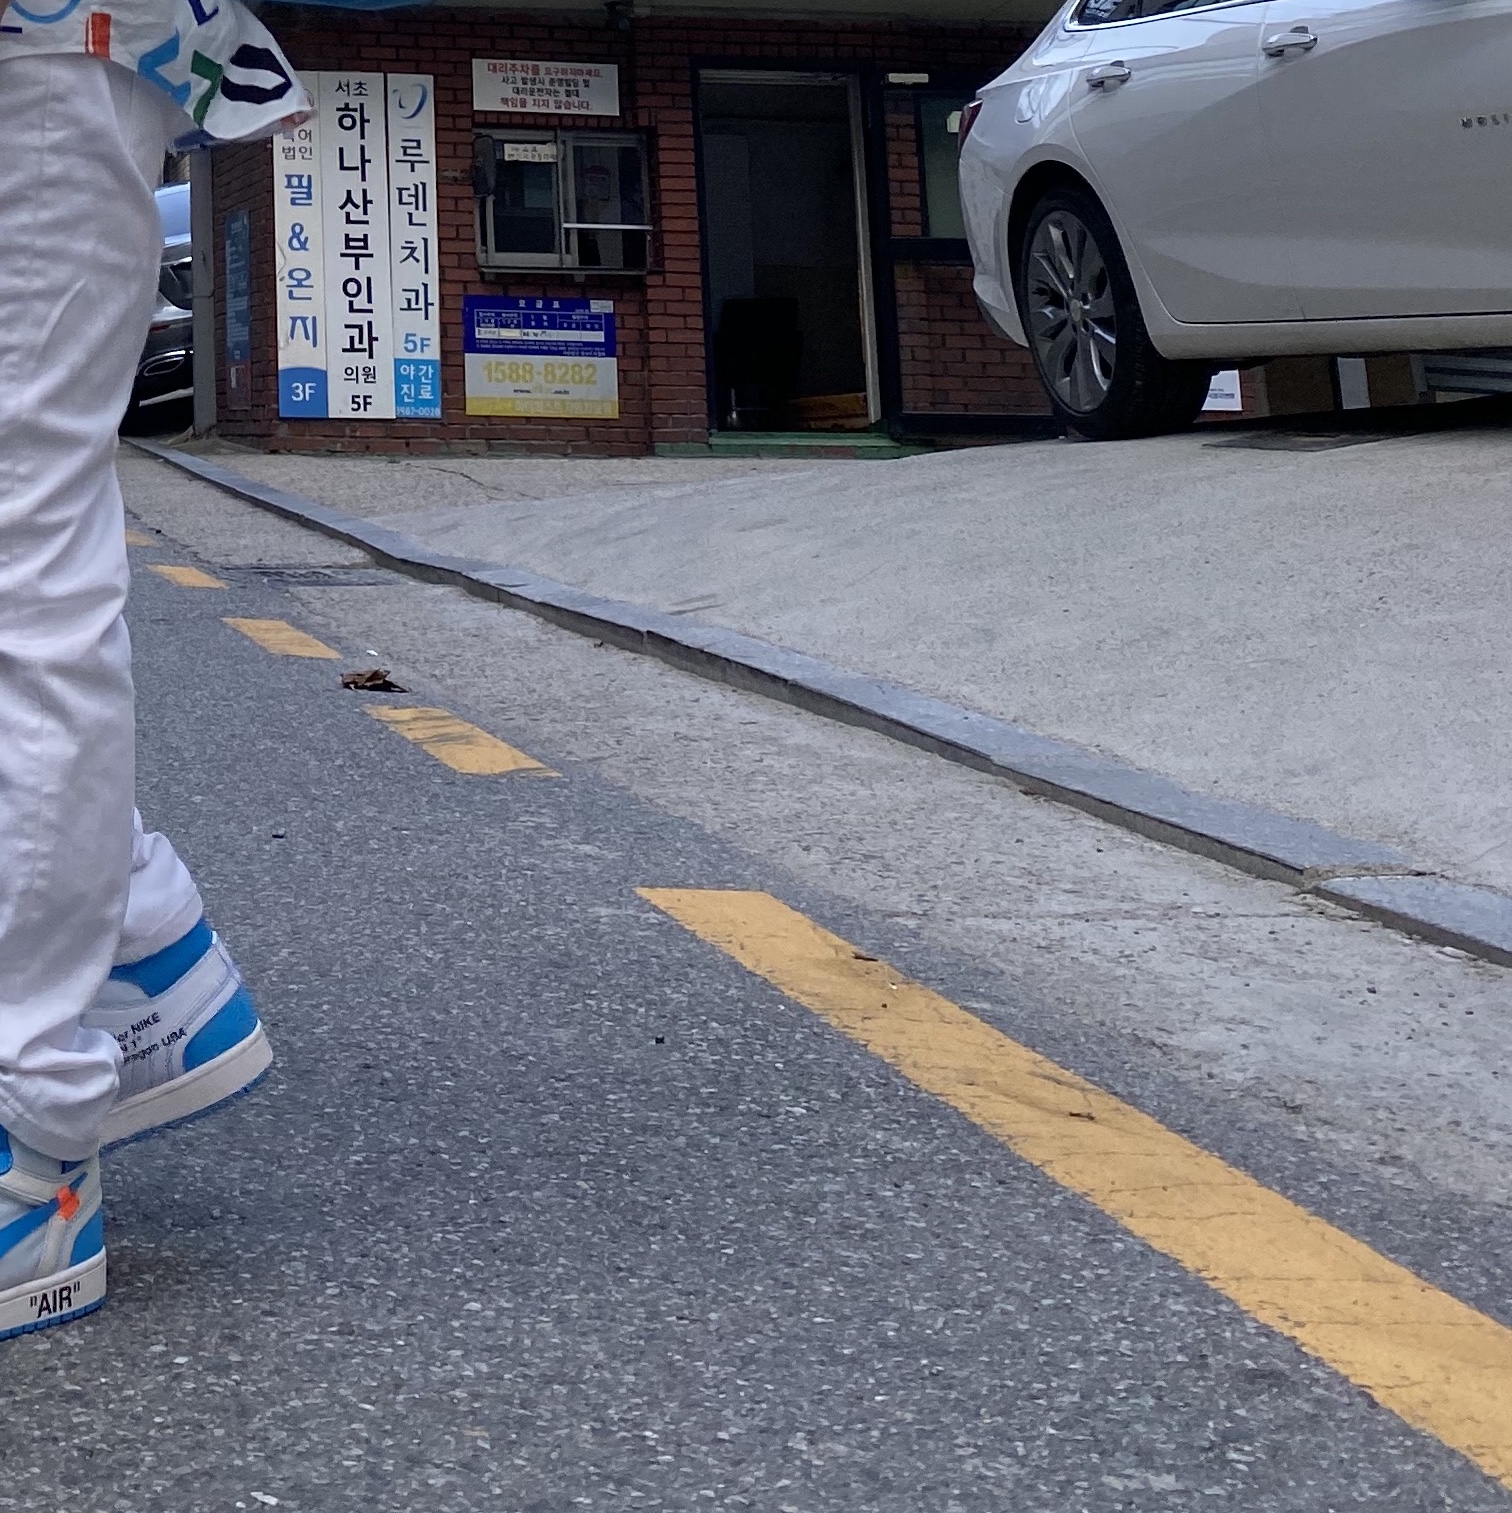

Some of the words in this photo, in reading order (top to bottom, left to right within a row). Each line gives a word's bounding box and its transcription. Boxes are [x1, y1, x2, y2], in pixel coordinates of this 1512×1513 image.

[488, 62, 540, 75] 대리주차를
[335, 79, 369, 96] 서초
[532, 99, 550, 108] 지지
[282, 146, 312, 160] 법인
[335, 102, 379, 360] 하나산부인과
[395, 139, 435, 321] 루덴치과
[403, 333, 431, 354] 5F
[344, 365, 377, 384] 의원
[400, 364, 434, 383] 야간
[483, 361, 598, 385] 1588-8282
[291, 382, 317, 402] 3F
[400, 384, 434, 403] 진료
[351, 395, 373, 412] 5F
[131, 1012, 161, 1035] NIKE
[161, 1027, 188, 1047] USA
[29, 1280, 81, 1318] "AIR"
